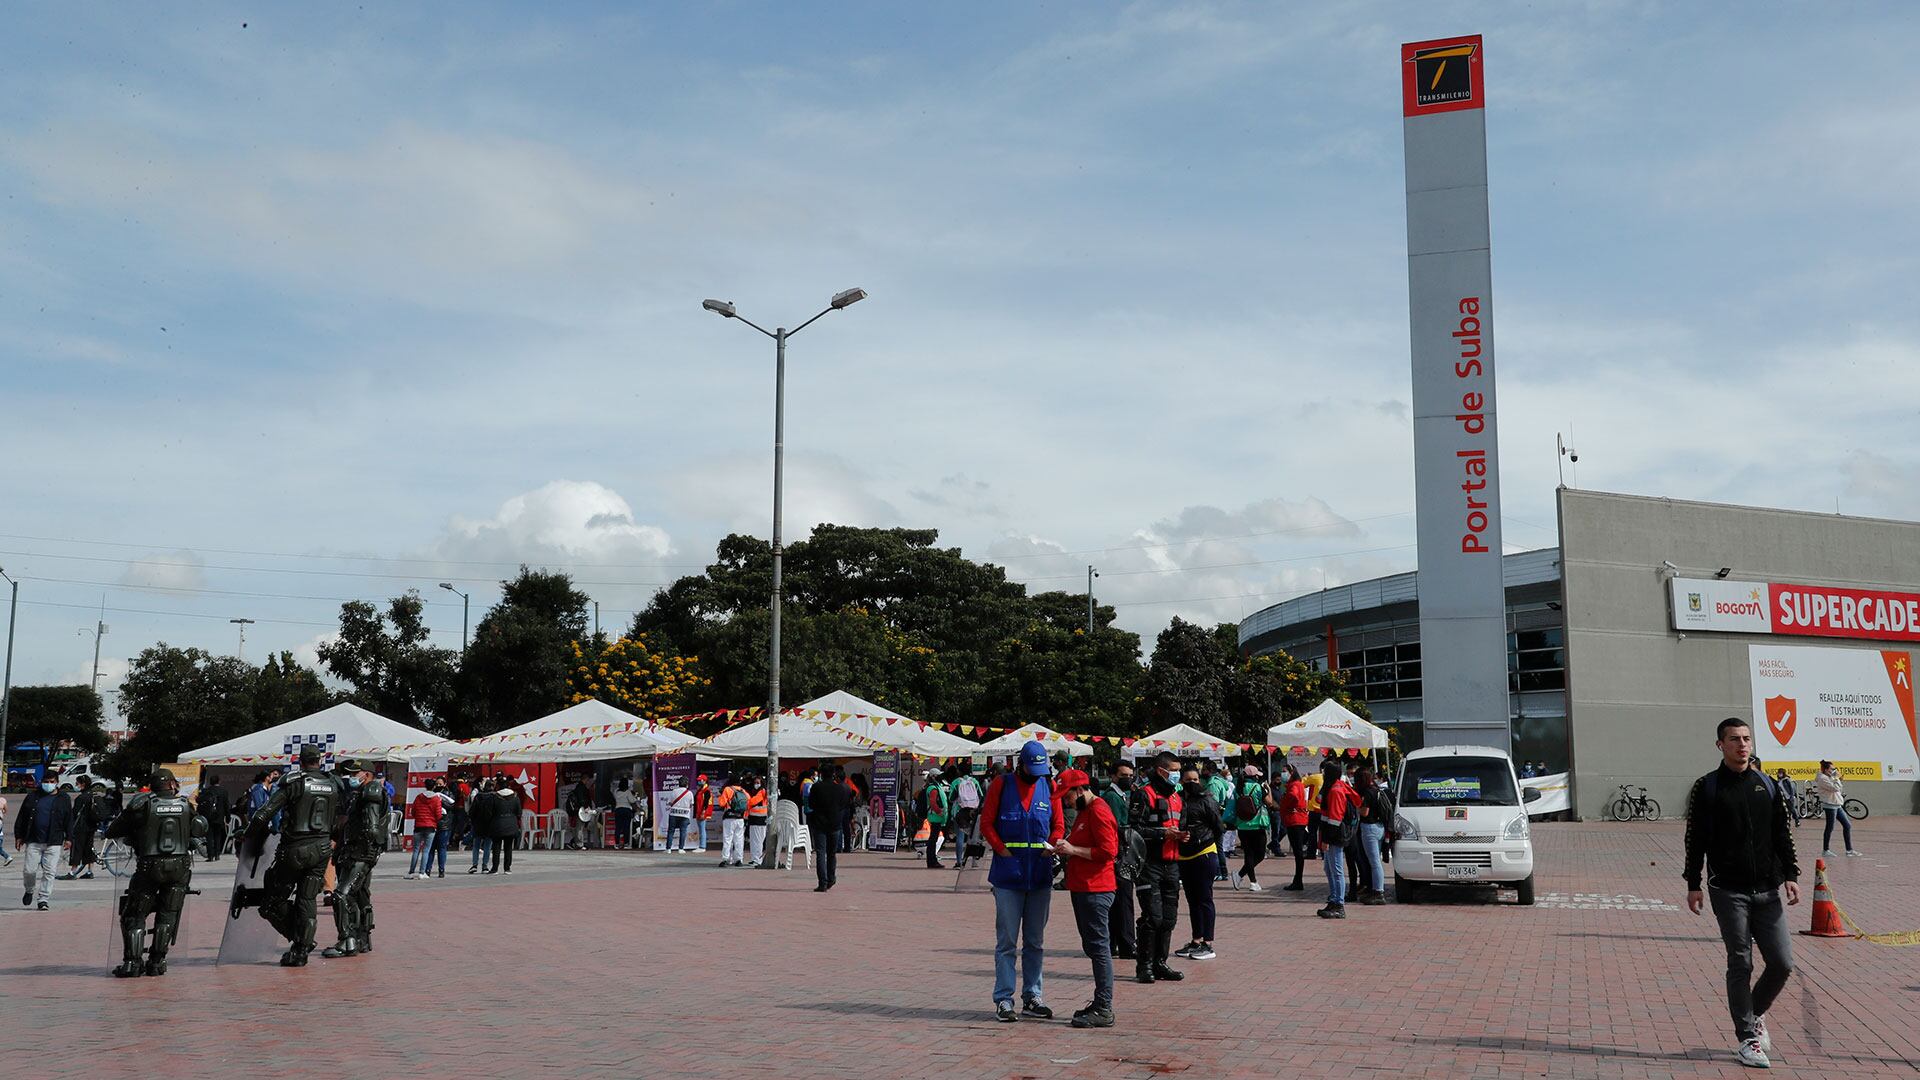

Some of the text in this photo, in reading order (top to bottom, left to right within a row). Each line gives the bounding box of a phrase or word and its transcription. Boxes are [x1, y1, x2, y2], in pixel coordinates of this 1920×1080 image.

[1419, 91, 1470, 102] TRANSMILENIO
[1452, 297, 1489, 553] Portal de Suba
[1779, 591, 1920, 633] SUPERCADE
[1819, 693, 1882, 704] REALIZA AQUÍ TODOS
[1830, 706, 1873, 716] TUS TRÁMITES
[1814, 718, 1886, 729] SIN INTERMEDIARIOS
[1839, 767, 1874, 775] TIENE COSTO
[1448, 867, 1477, 875] GUV 348
